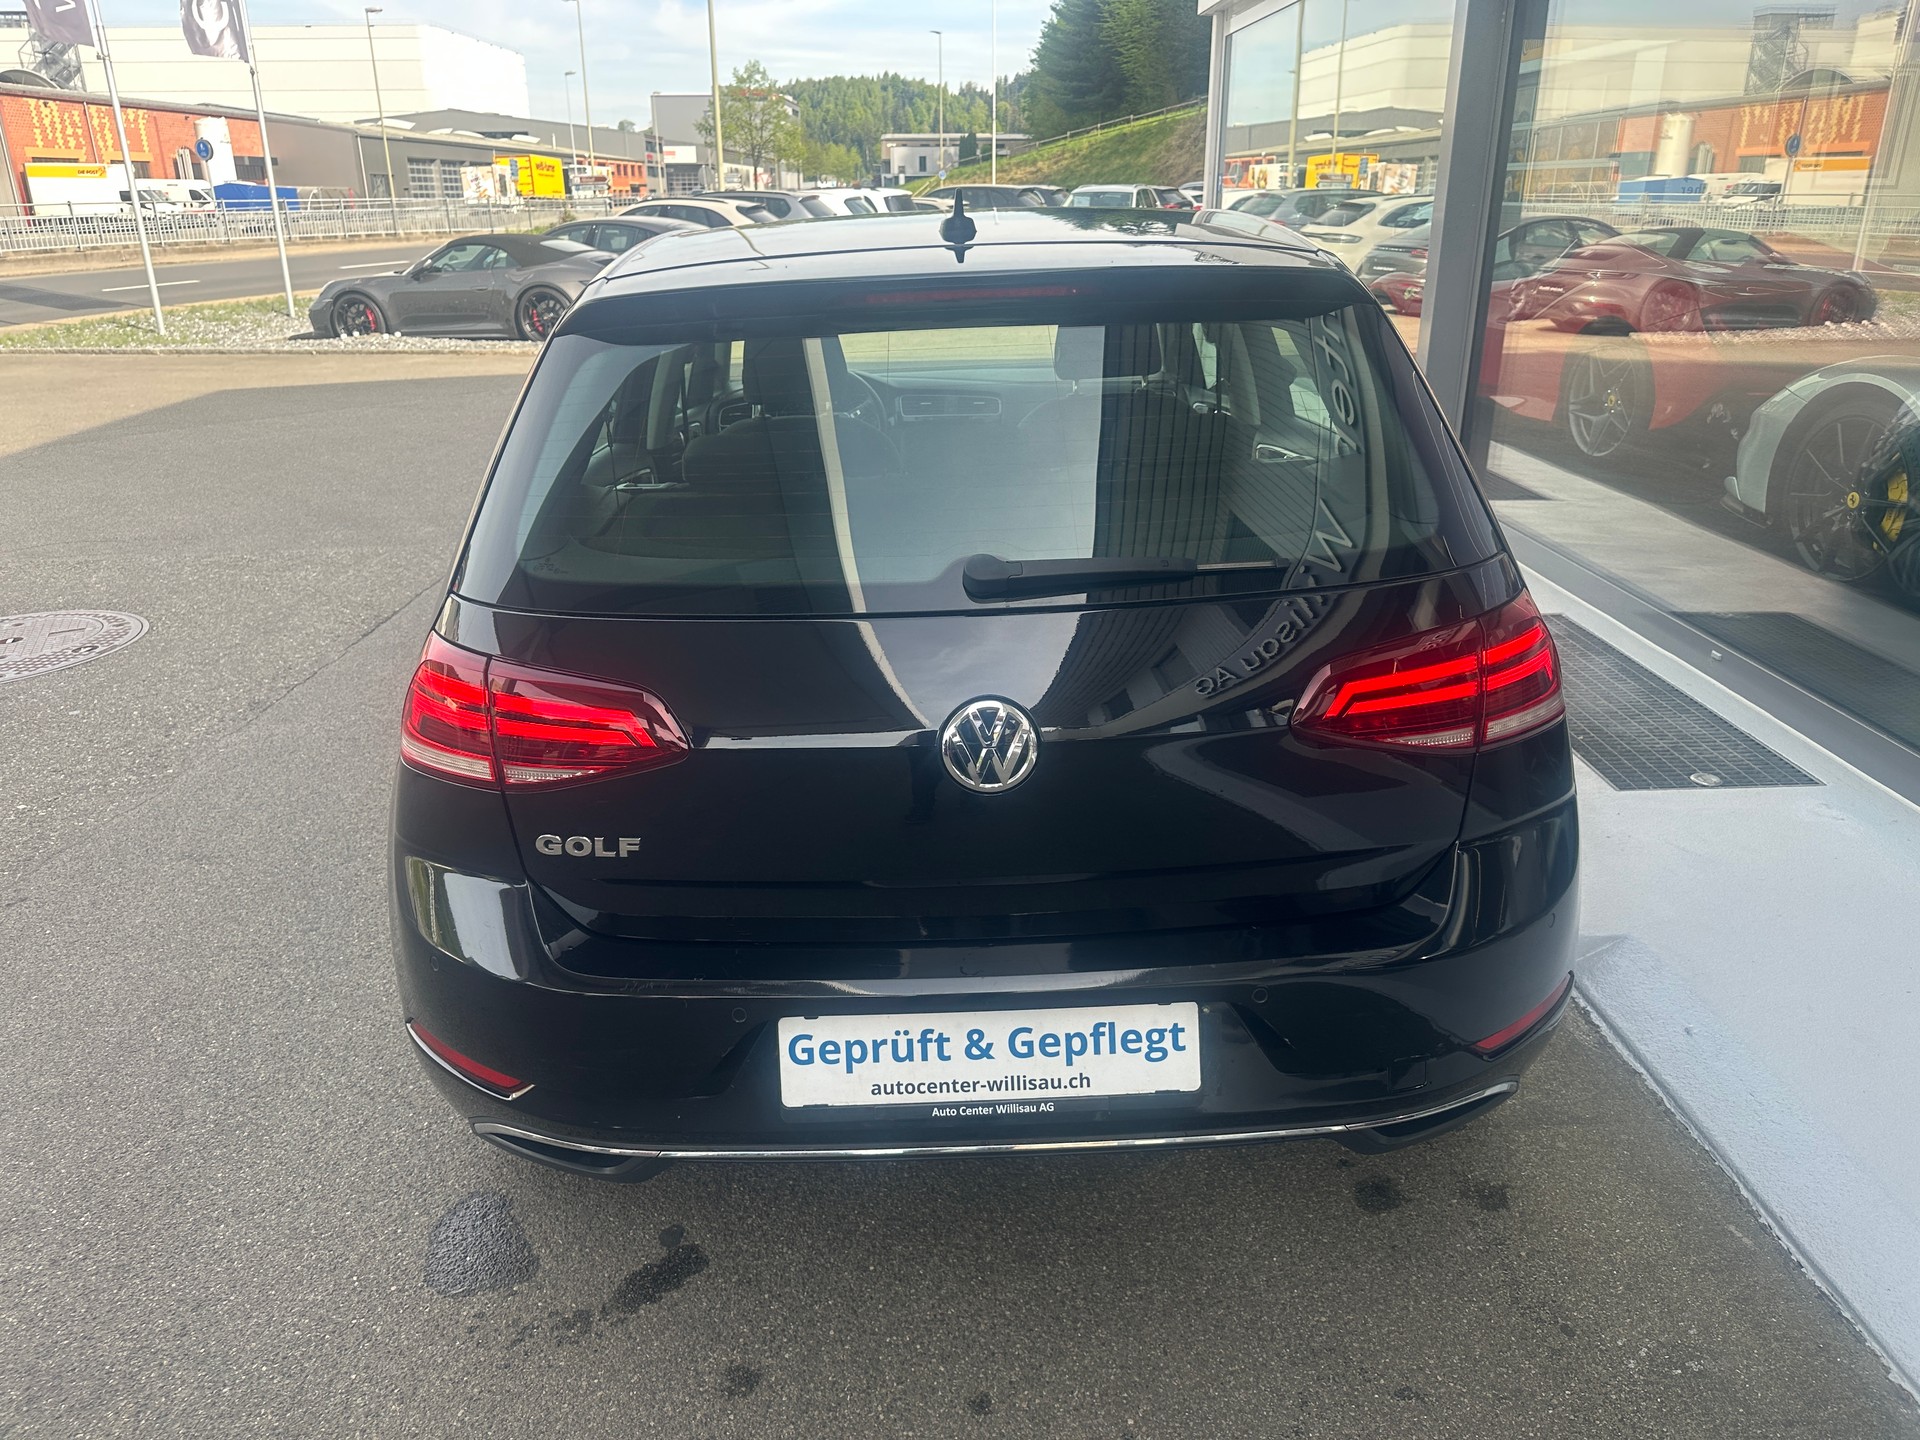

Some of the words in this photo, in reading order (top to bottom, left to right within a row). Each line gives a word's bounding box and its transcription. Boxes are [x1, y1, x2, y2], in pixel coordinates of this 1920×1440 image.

[535, 834, 641, 858] GOLF
[787, 1028, 951, 1074] Geprüft
[964, 1029, 996, 1061] &
[1007, 1020, 1187, 1067] Gepflegt
[870, 1072, 1091, 1096] autocenter-willisau.ch
[931, 1107, 957, 1117] Auto
[959, 1106, 994, 1116] Center
[996, 1103, 1037, 1114] Willisau
[1039, 1102, 1055, 1112] AG
